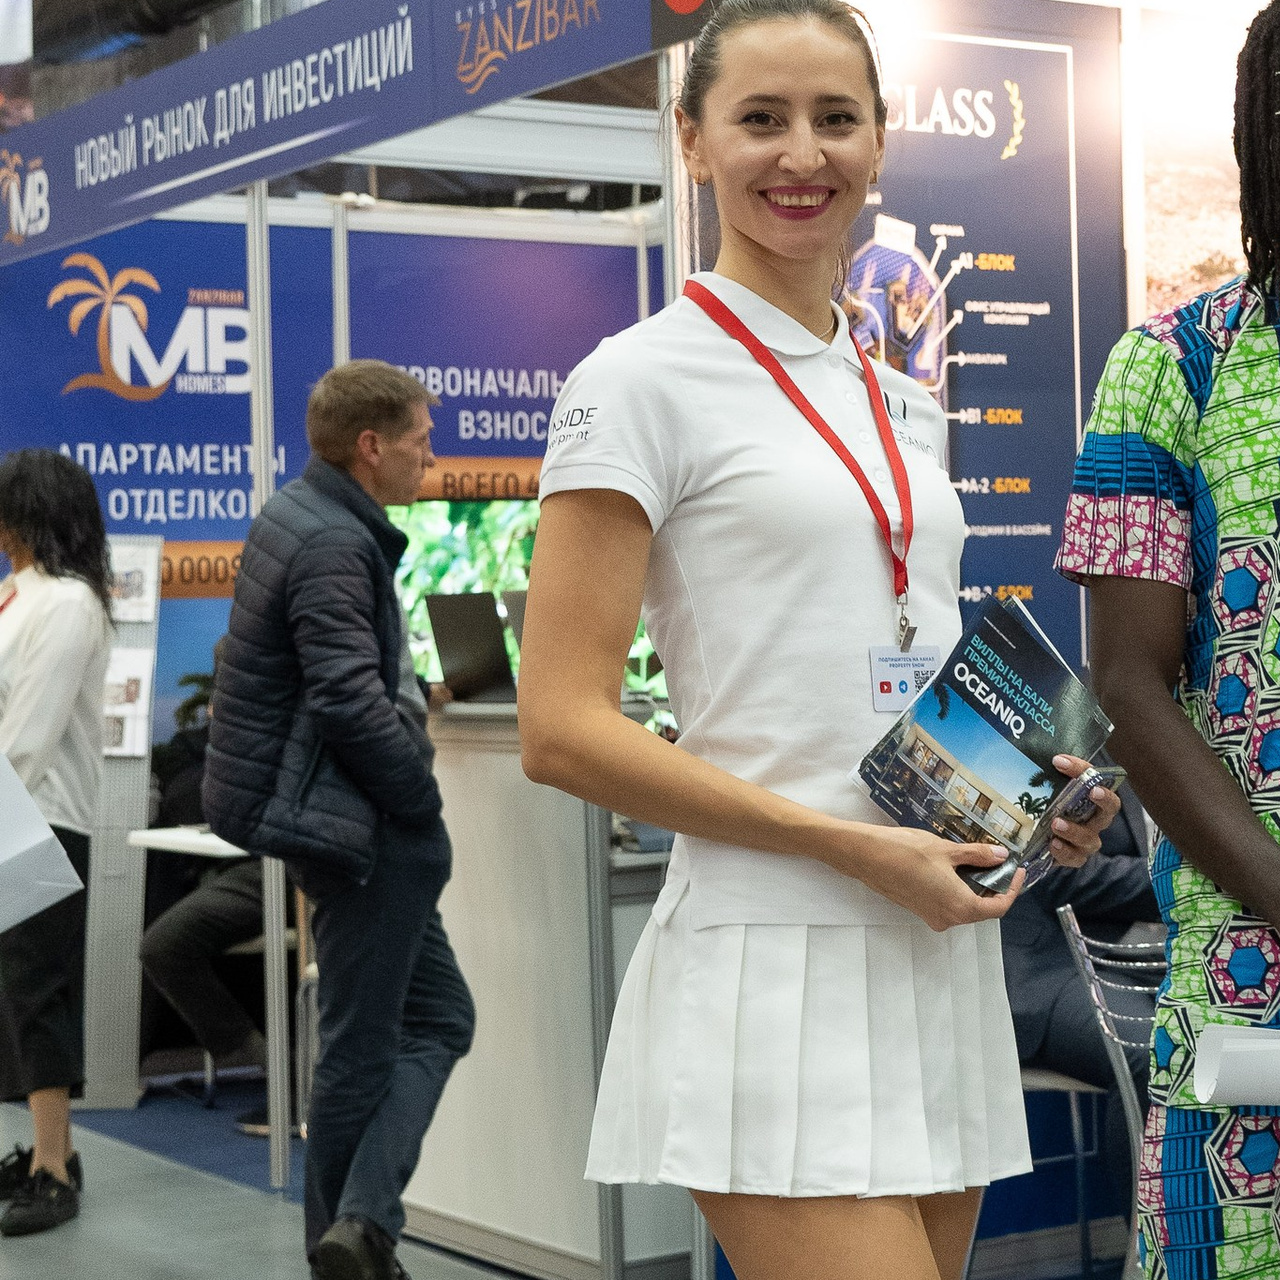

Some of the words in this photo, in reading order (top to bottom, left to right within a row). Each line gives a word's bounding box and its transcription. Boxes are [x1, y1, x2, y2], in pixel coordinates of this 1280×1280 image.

[75, 114, 137, 190] НОВЫЙ
[142, 97, 209, 166] РЫНОК
[213, 77, 255, 148] ДЛЯ
[262, 3, 413, 123] ИНВЕСТИЦИЙ
[459, 410, 547, 441] ВЗНОС
[443, 472, 520, 498] ВСЕГО
[954, 663, 1025, 739] OCEANIQ
[964, 646, 1055, 737] ПРЕМИУМ-КЛАССА
[971, 633, 1009, 675] ВИЛЛЫ
[1006, 670, 1023, 690] НА
[1021, 684, 1053, 716] БАЛИ
